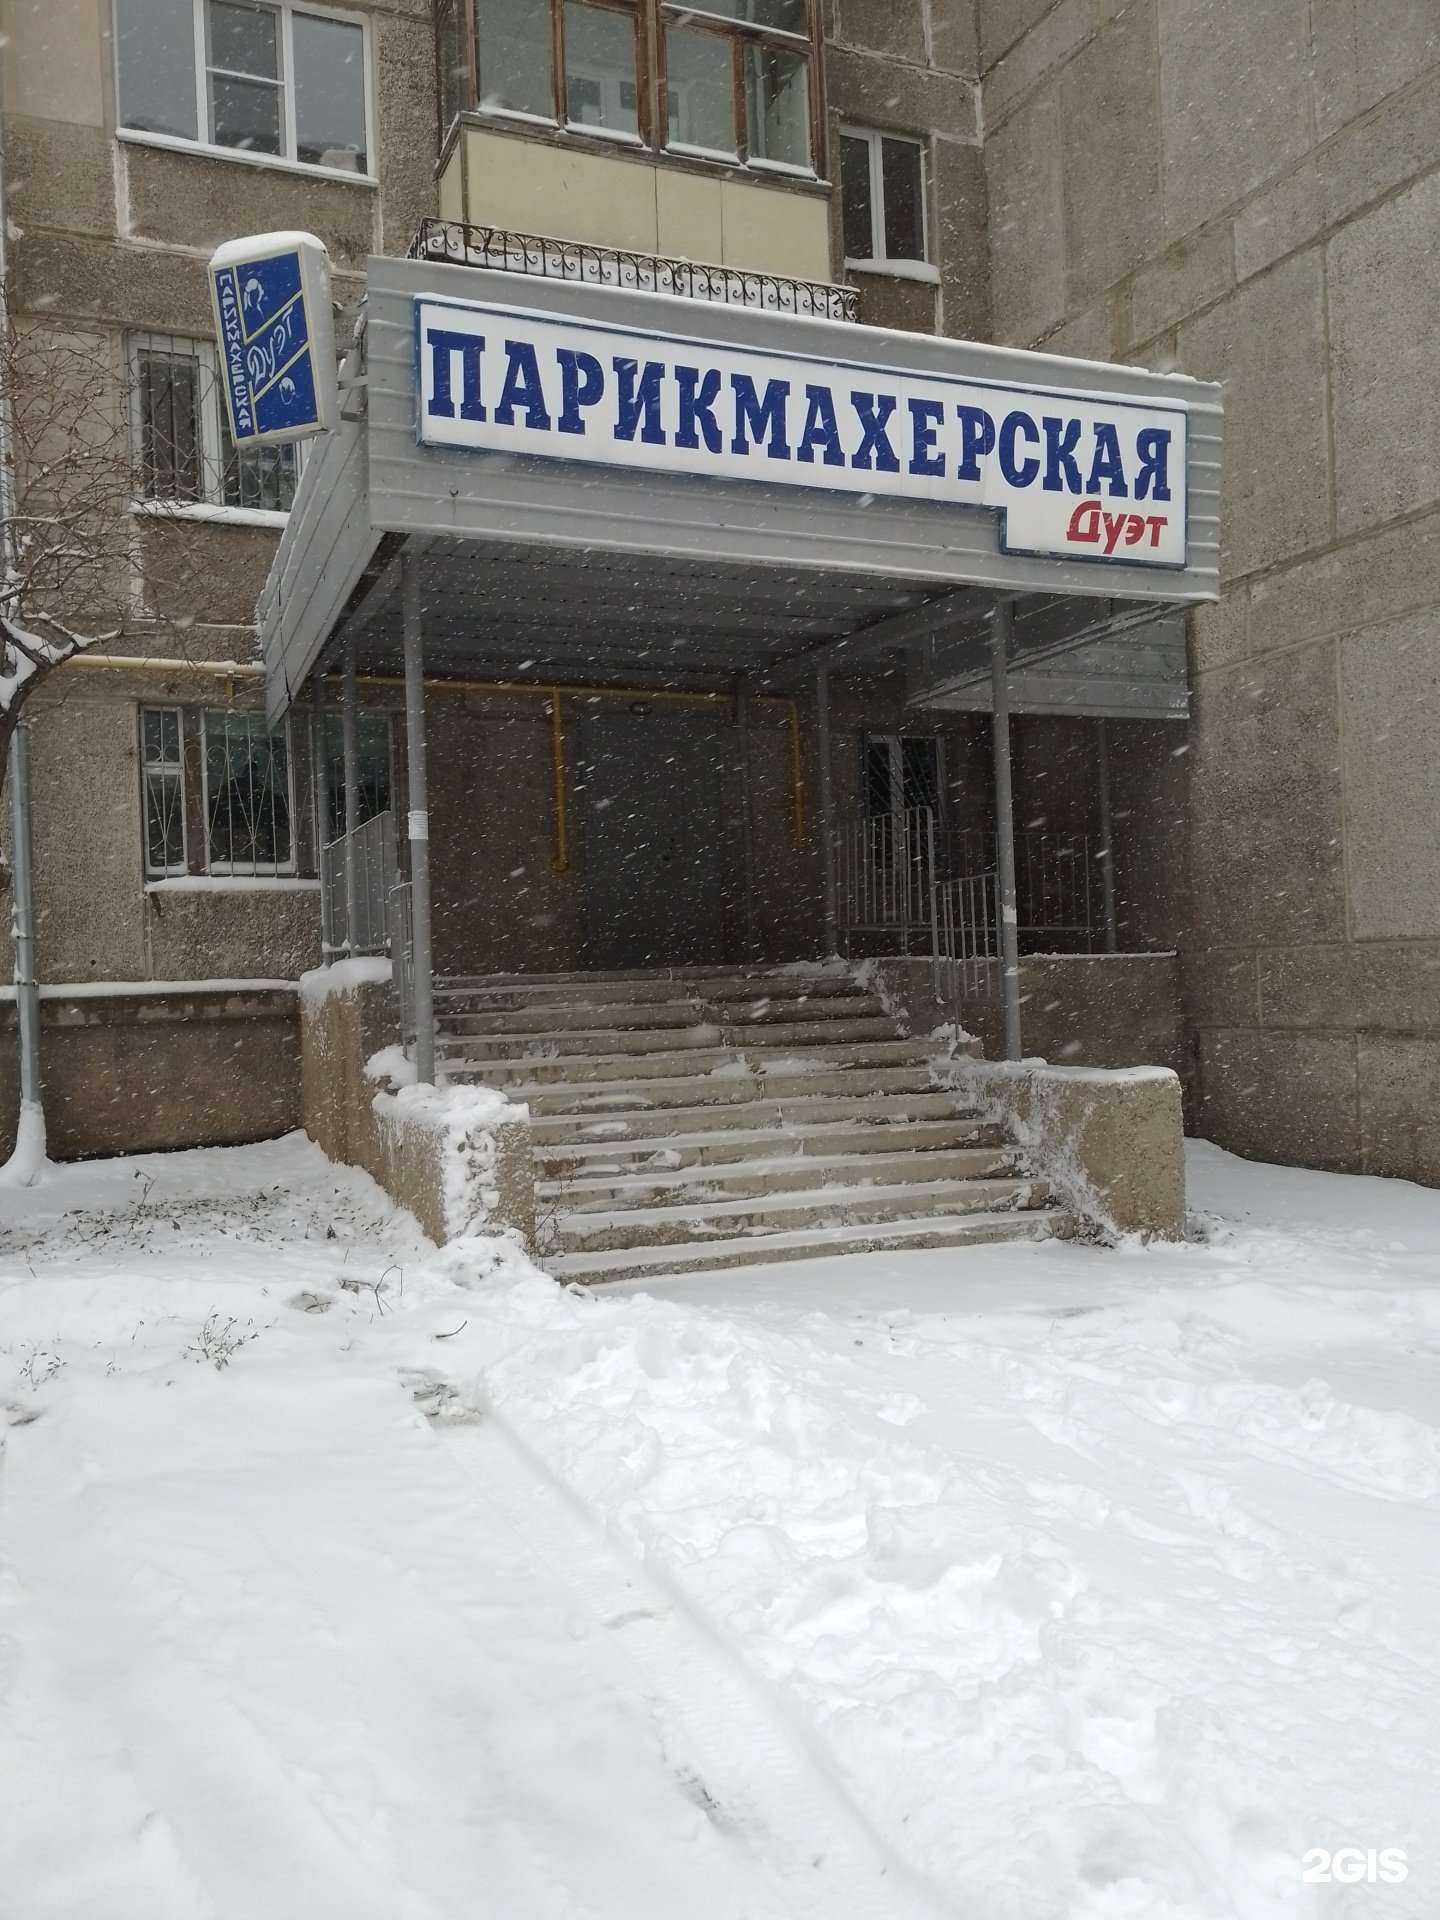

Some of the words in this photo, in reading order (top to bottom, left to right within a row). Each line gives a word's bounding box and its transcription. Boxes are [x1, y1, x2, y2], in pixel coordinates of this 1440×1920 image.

[219, 273, 252, 429] ПАРИКМАХЕРСКАЯ
[426, 327, 1172, 502] ПАРИКМАХЕРСКАЯ
[1066, 500, 1169, 555] Дуэт
